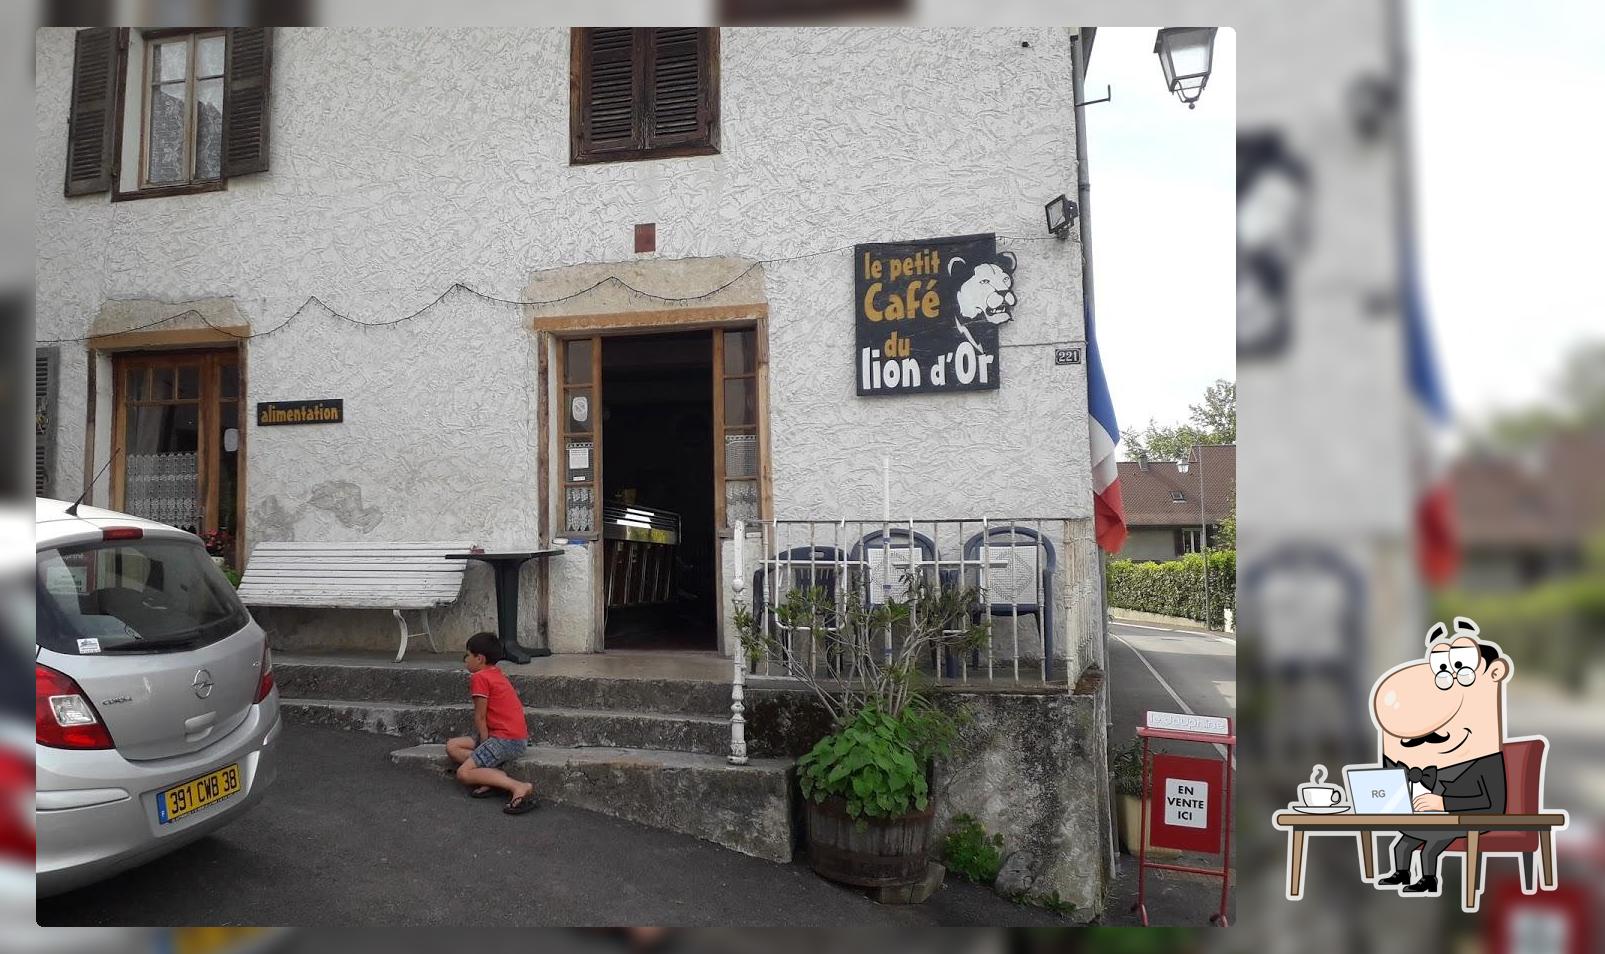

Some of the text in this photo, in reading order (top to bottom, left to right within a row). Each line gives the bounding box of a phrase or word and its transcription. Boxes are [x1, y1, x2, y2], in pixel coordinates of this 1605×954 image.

[864, 249, 941, 281] le petit
[864, 279, 941, 322] Café
[884, 331, 912, 358] du
[1057, 349, 1079, 363] 221
[862, 341, 994, 389] lion d'Or
[261, 402, 339, 423] alimentation
[170, 786, 193, 814] 391
[196, 775, 220, 803] CWB
[222, 768, 238, 792] 38
[1177, 785, 1194, 796] EN
[1167, 796, 1205, 810] VENTE
[1177, 810, 1193, 821] ICI
